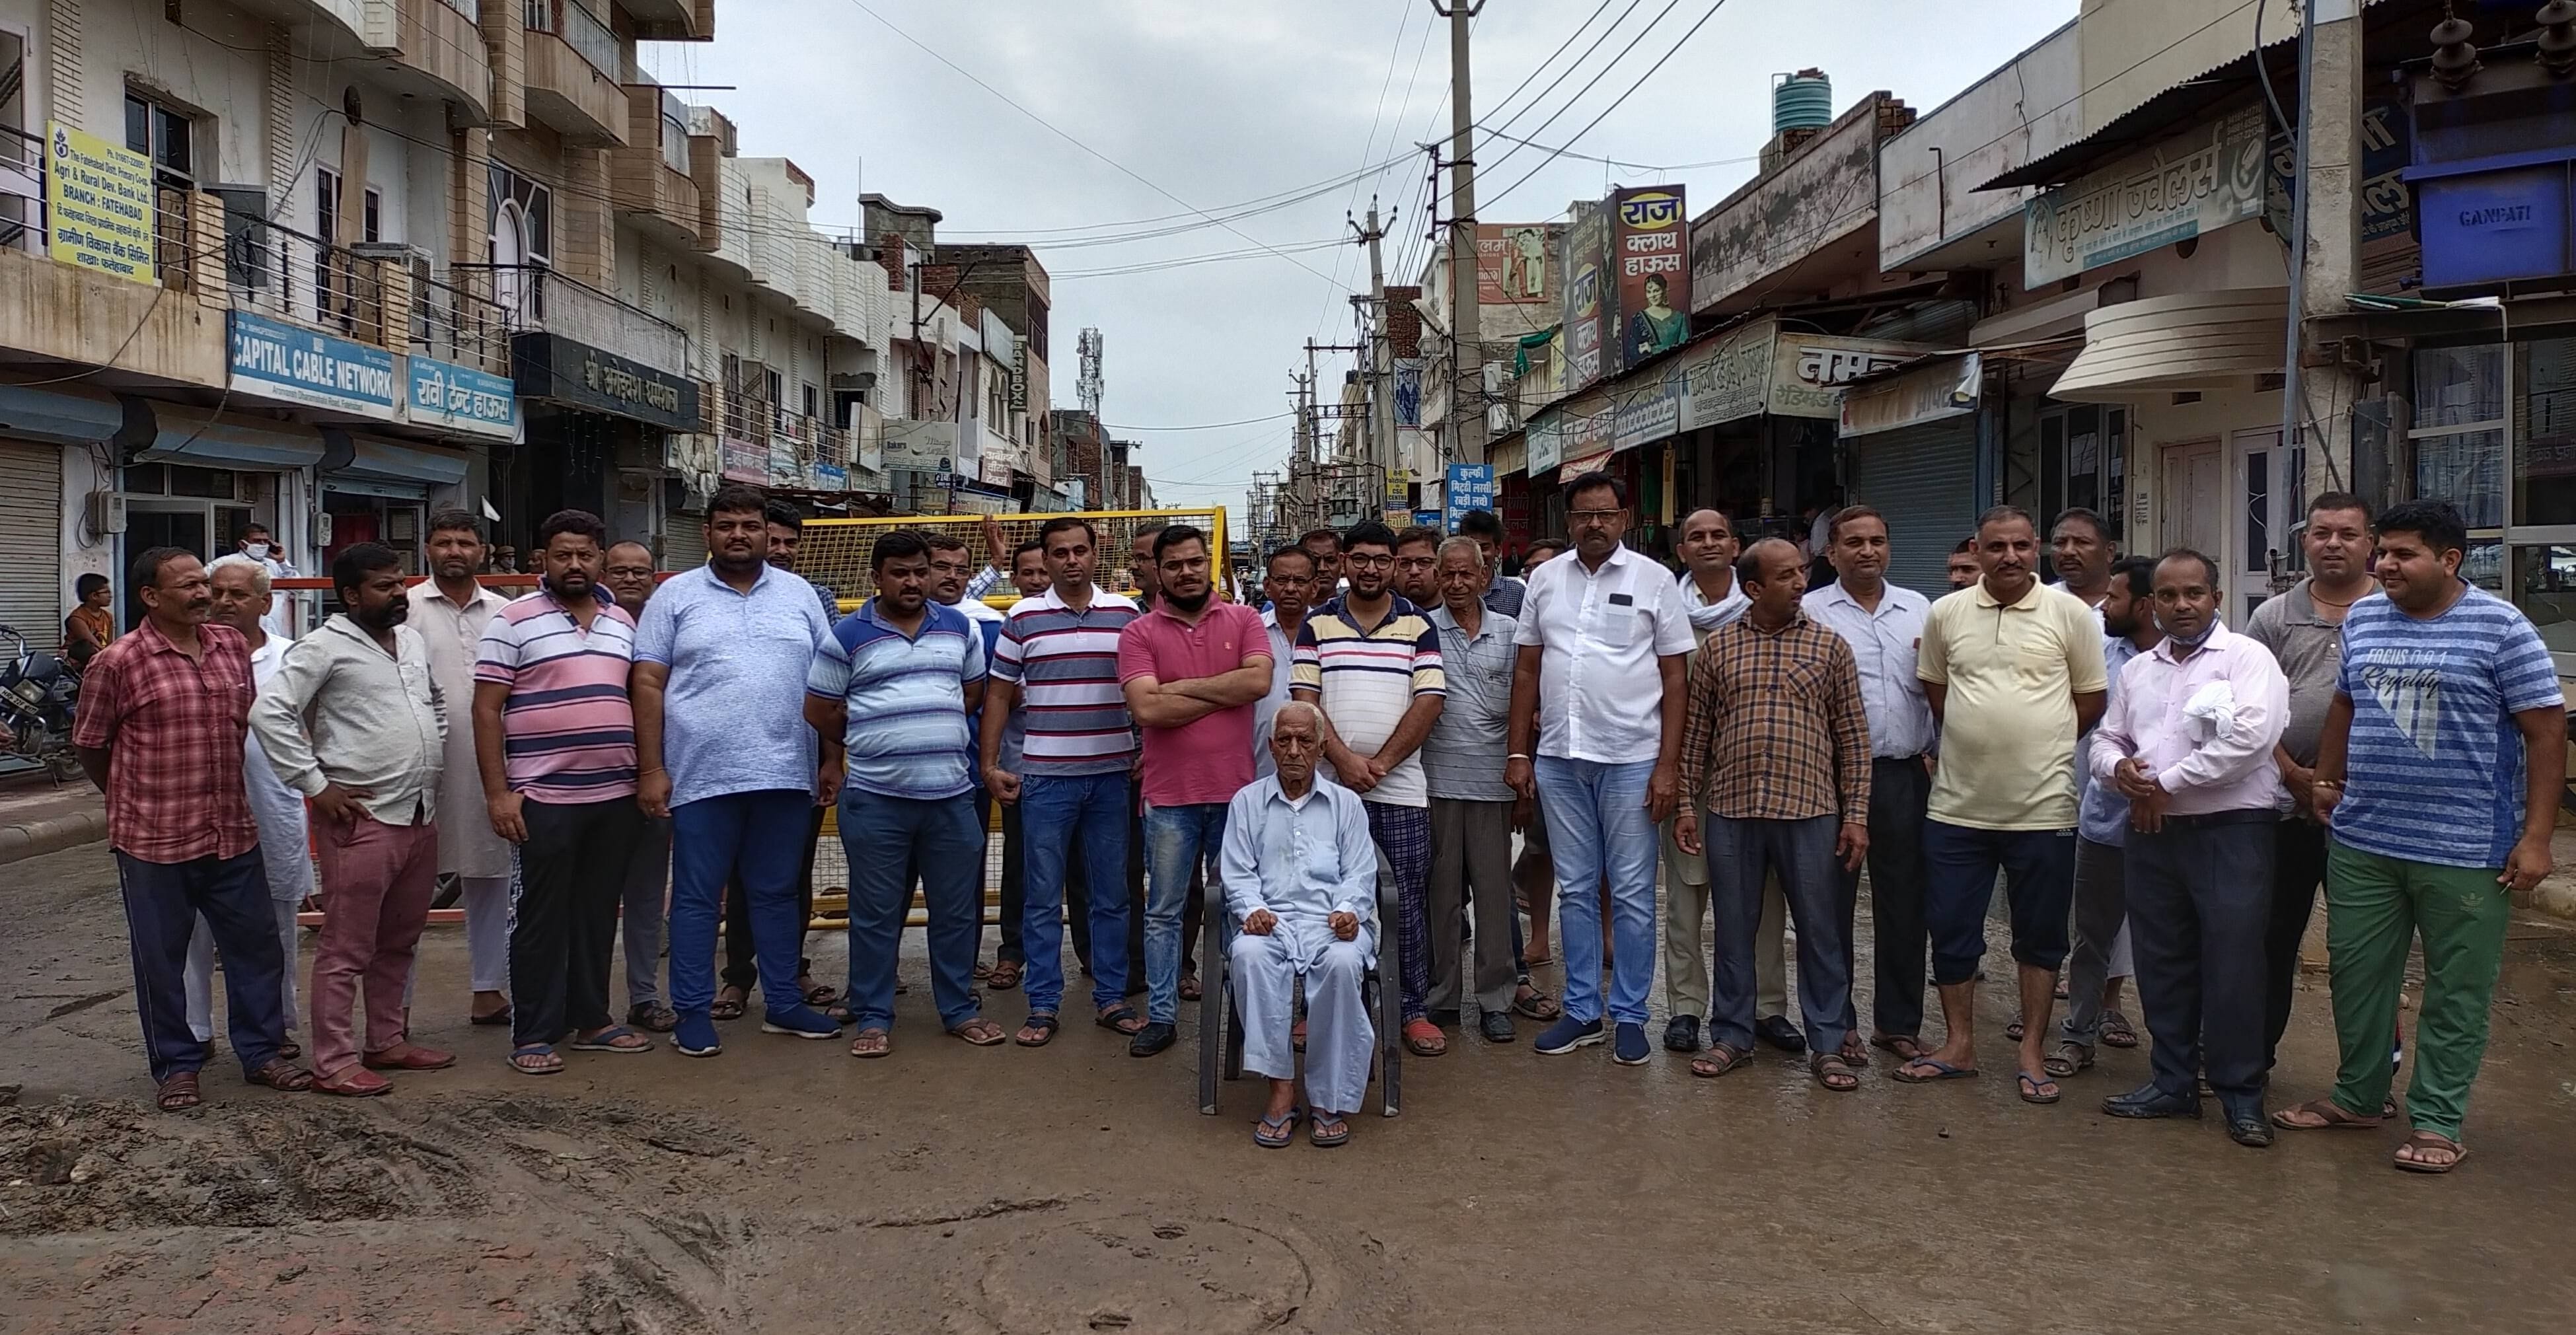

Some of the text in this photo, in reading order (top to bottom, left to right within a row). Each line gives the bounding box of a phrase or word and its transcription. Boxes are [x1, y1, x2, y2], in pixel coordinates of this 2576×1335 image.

[54, 161, 149, 203] Agri & Rural Dev. Bank Ltd.
[70, 149, 80, 162] The
[118, 167, 135, 184] Primary
[63, 184, 95, 206] BRANCH
[102, 197, 143, 221] FATEHABAD
[1621, 197, 1681, 225] राज
[2459, 205, 2530, 227] GANPATI
[2055, 182, 2121, 263] कृष्णा
[57, 227, 84, 247] ग्रामीण
[86, 231, 110, 254] विकास
[1626, 231, 1678, 252] क्लाथ
[101, 257, 134, 275] फतेहाबाद
[1624, 254, 1681, 276] हाऊस
[1574, 266, 1598, 312] राज
[234, 333, 392, 400] CAPITAL CABLE NETWORK
[585, 349, 599, 391] श्री
[1010, 342, 1025, 400] BANDBOX
[417, 371, 445, 408] रावी
[472, 390, 510, 421] हाऊस
[1460, 466, 1485, 481] कुल्फी
[1454, 493, 1471, 508] रबड़ी
[2366, 649, 2409, 665] FOCUS
